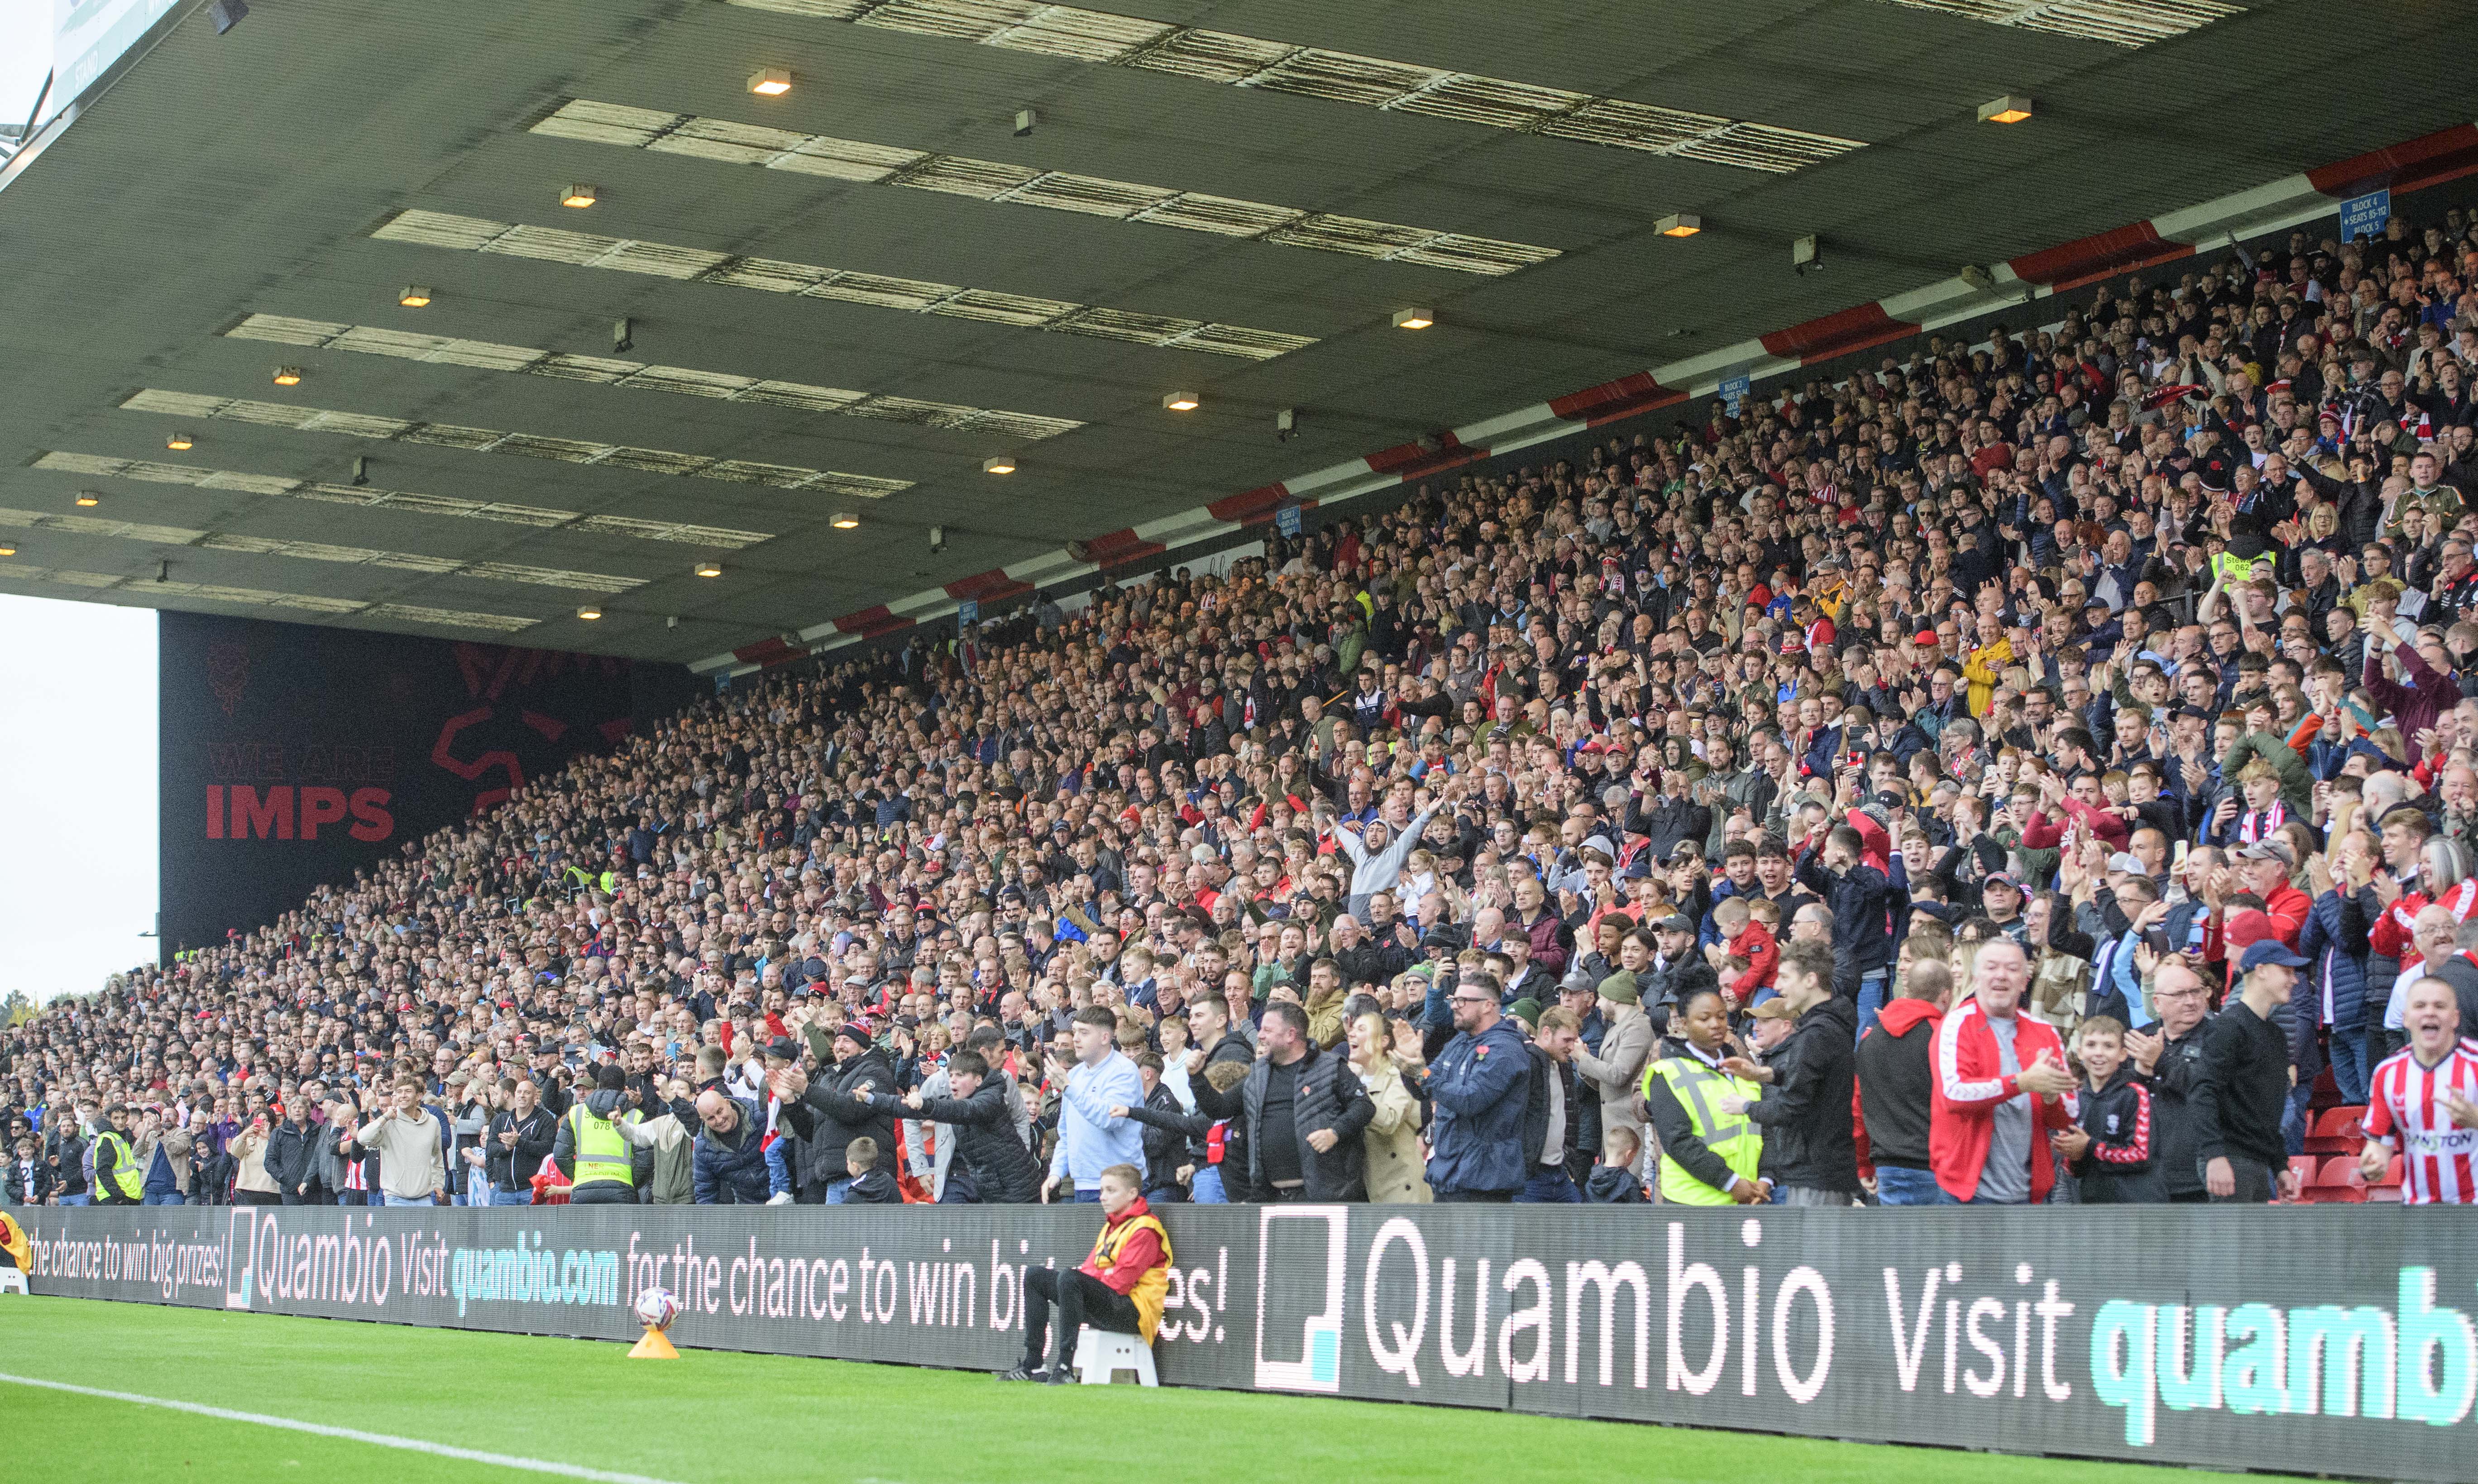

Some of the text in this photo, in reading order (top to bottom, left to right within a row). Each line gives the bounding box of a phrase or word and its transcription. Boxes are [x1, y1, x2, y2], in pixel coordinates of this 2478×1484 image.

[75, 50, 98, 90] STAND
[2349, 206, 2387, 225] SEATS 85-112
[2352, 197, 2378, 212] BLOCK 4
[2354, 220, 2379, 234] BLOCK 5
[1723, 392, 1735, 401] SEATS
[1725, 381, 1738, 392] BLOCK
[206, 742, 398, 782] WE ARE
[206, 785, 394, 842] IMPS
[594, 1121, 610, 1130] 078
[29, 1228, 226, 1299] the chance to win big prizes!
[258, 1213, 392, 1306] Quambio
[401, 1230, 450, 1297] Visit
[451, 1230, 620, 1317] quambio.com
[627, 1231, 669, 1307] for
[672, 1235, 721, 1315] the
[729, 1236, 849, 1322] chance
[859, 1247, 897, 1324] to
[908, 1238, 976, 1327] win
[1363, 1216, 1836, 1405] Quambio
[1883, 1262, 2076, 1403] Visit
